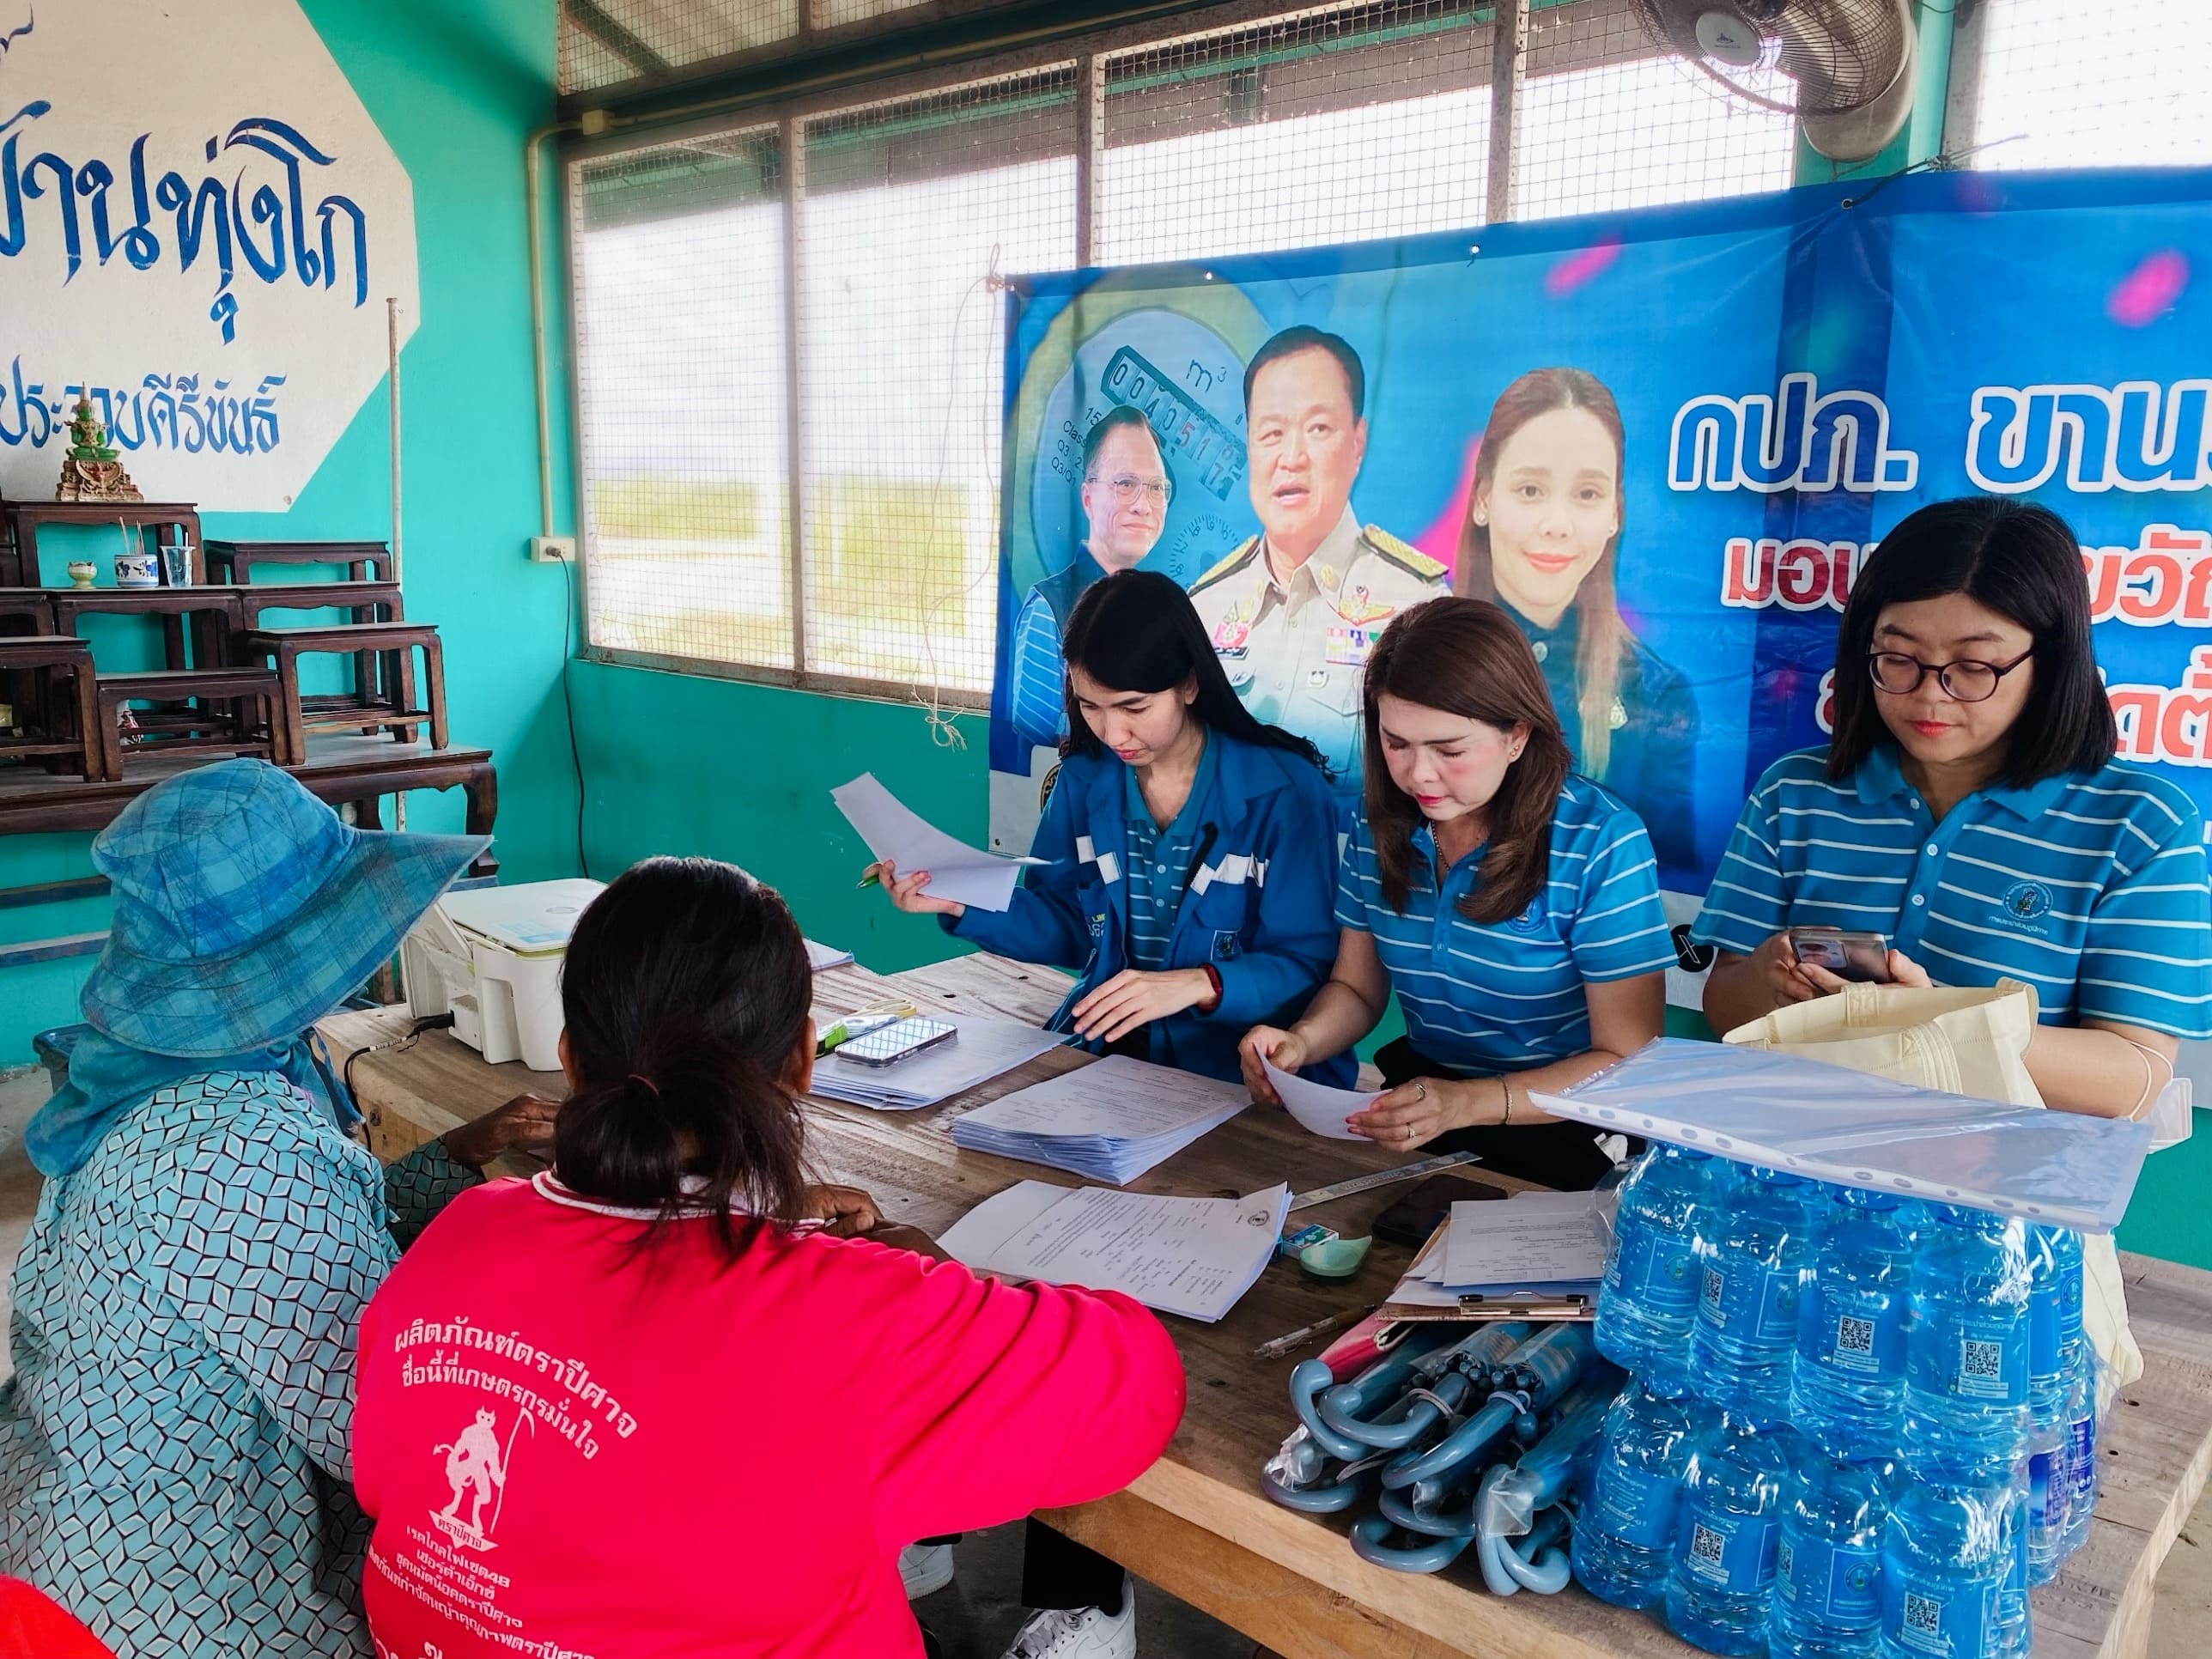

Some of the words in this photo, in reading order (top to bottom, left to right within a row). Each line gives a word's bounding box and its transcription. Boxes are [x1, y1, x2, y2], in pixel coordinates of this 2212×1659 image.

[0, 354, 289, 456] ประวบคีรีขันธ์
[1668, 373, 1918, 492] กปภ.
[1966, 378, 2212, 494] ขาน
[394, 1316, 638, 1439] ผลิตภัณฑ์ตราปีศาจ
[402, 1350, 599, 1460] ชื่อนี้ที่เกษตรกรมั่นใจ
